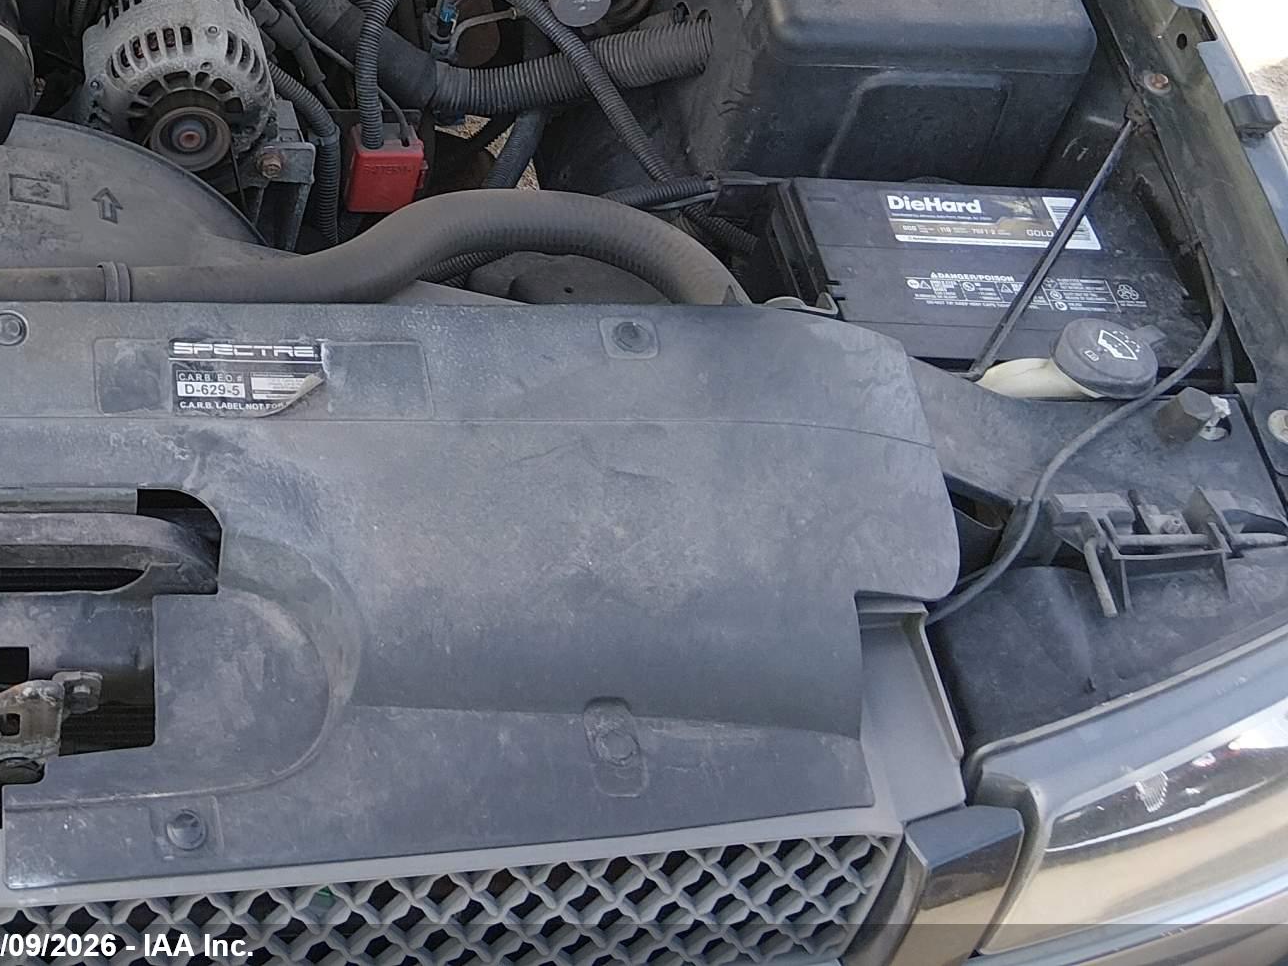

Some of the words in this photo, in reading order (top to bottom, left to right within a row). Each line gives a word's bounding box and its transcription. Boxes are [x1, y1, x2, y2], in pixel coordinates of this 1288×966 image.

[887, 194, 982, 214] DieHard
[1026, 228, 1055, 238] GOLD
[185, 384, 241, 396] D-629-5
[215, 402, 243, 411] LABEL
[244, 402, 264, 411] NOT
